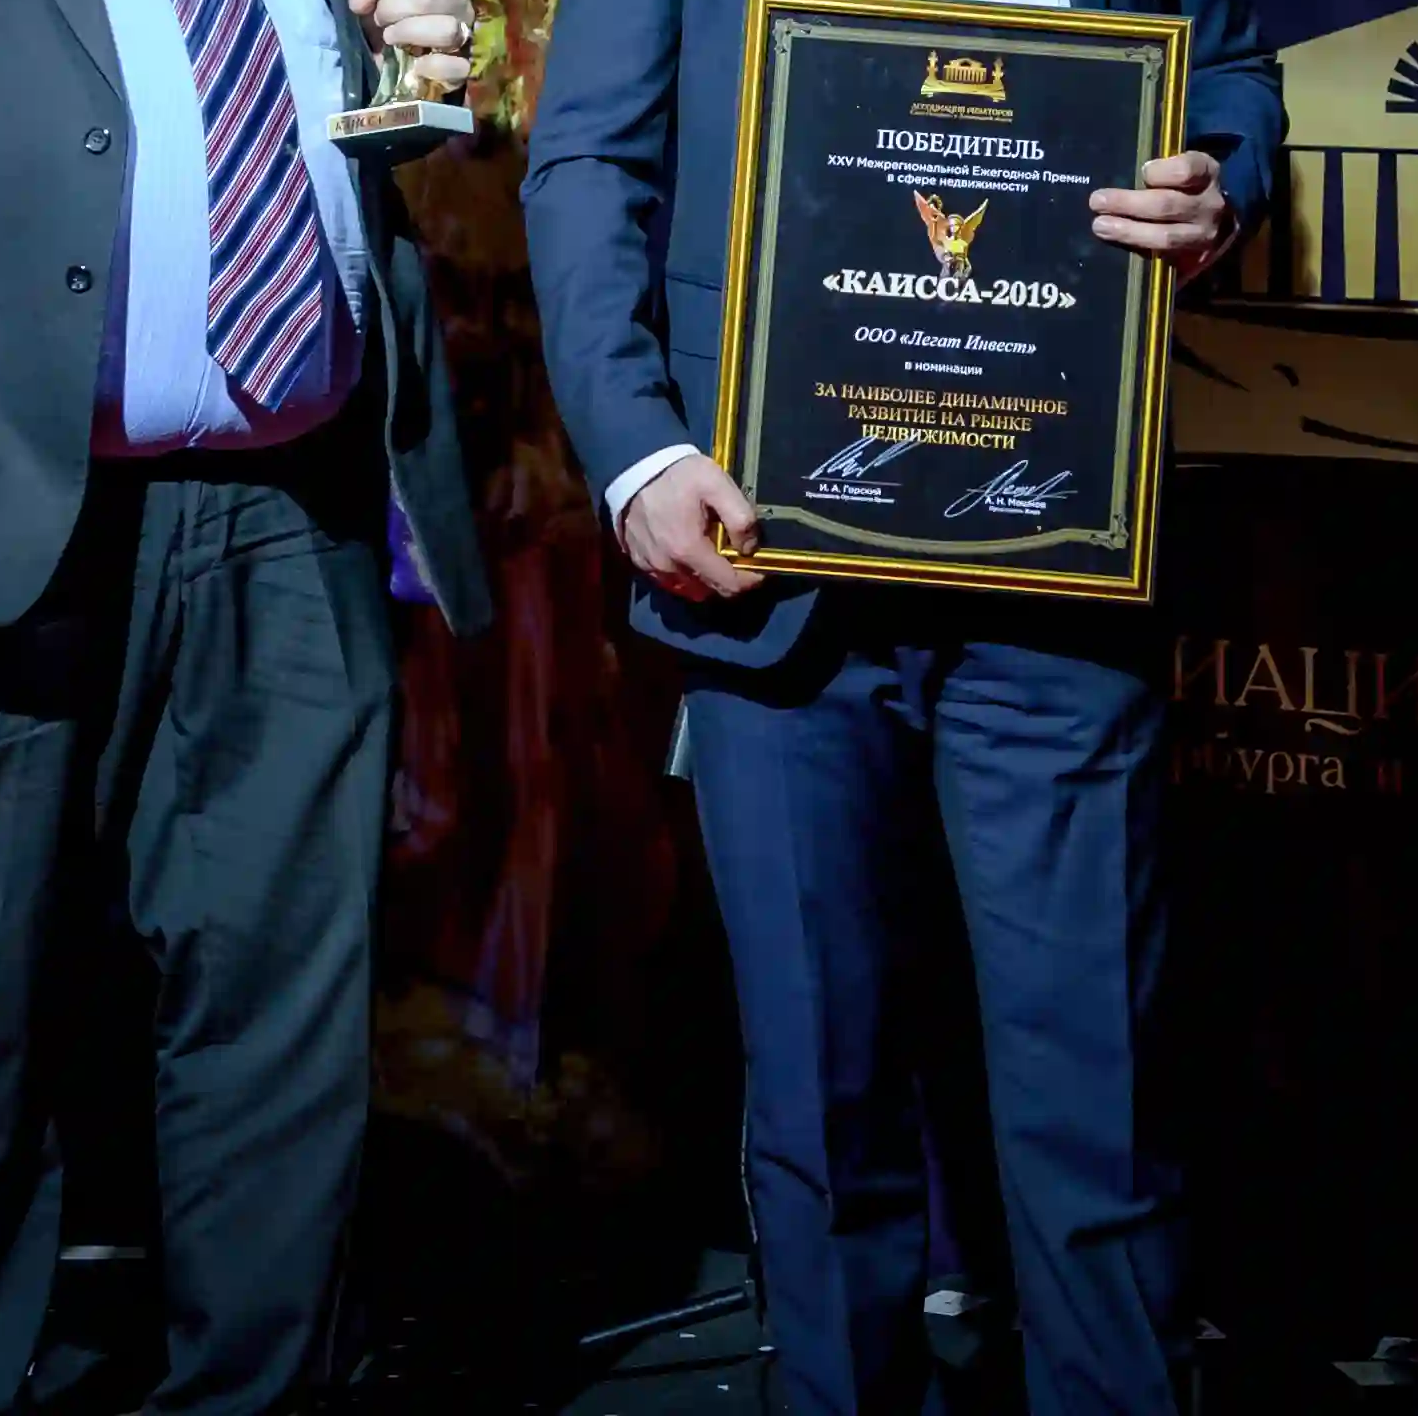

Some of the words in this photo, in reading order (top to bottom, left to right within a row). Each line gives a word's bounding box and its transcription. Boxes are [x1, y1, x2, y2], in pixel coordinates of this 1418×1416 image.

[876, 129, 1045, 160] ПОБЕДИТЕЛЬ
[827, 155, 854, 167] XXV
[856, 157, 969, 176] Межрегиональной
[972, 165, 1040, 181] Ежегодной
[1042, 171, 1090, 185] Премии
[887, 174, 895, 183] в
[897, 174, 937, 187] сфере
[939, 177, 1029, 193] недвижимости
[822, 268, 1077, 309] «КАИССА-2019»
[854, 326, 896, 343] ООО
[899, 330, 961, 349] «Легат
[963, 335, 1037, 355] Инвест»
[904, 362, 912, 371] в
[914, 361, 983, 376] номинации
[814, 382, 837, 399] ЗА
[840, 384, 936, 405] НАИБОЛЕЕ
[938, 391, 1069, 415] ДИНАМИЧНОЕ
[848, 404, 937, 424] РАЗВИТИЕ
[940, 411, 967, 428] НА
[969, 414, 1033, 432] РЫНКЕ
[862, 424, 1016, 450] НЕДВИЖИМОСТИ
